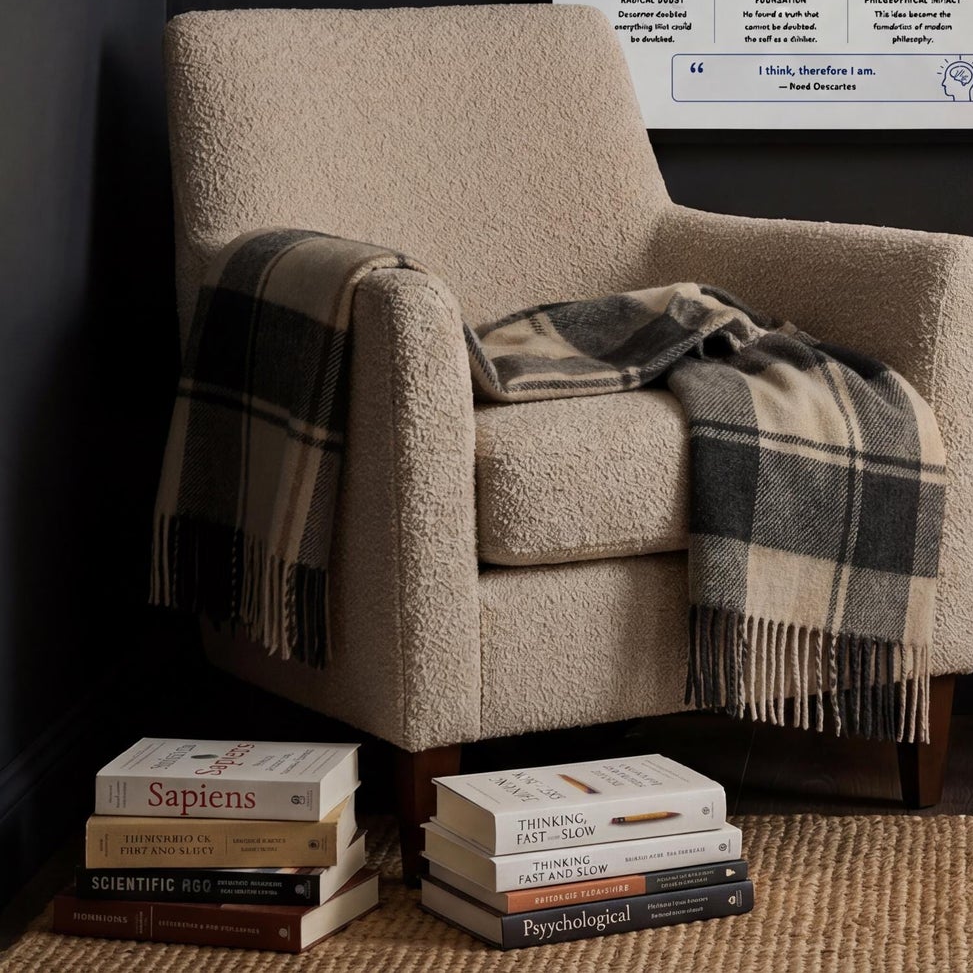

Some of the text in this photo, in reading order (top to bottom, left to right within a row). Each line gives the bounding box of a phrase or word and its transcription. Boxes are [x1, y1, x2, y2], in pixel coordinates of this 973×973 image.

[914, 22, 924, 31] of
[765, 64, 796, 77] think,
[798, 64, 848, 76] therefore
[856, 68, 876, 76] am.
[148, 781, 256, 816] Sapiens
[517, 812, 588, 831] THINKING,
[516, 825, 596, 845] FAST SLOW
[532, 855, 591, 871] THINKING
[518, 863, 609, 885] FAST AND SLOW
[91, 876, 175, 892] SCIENTIFIC
[523, 905, 631, 941] Psyychological
